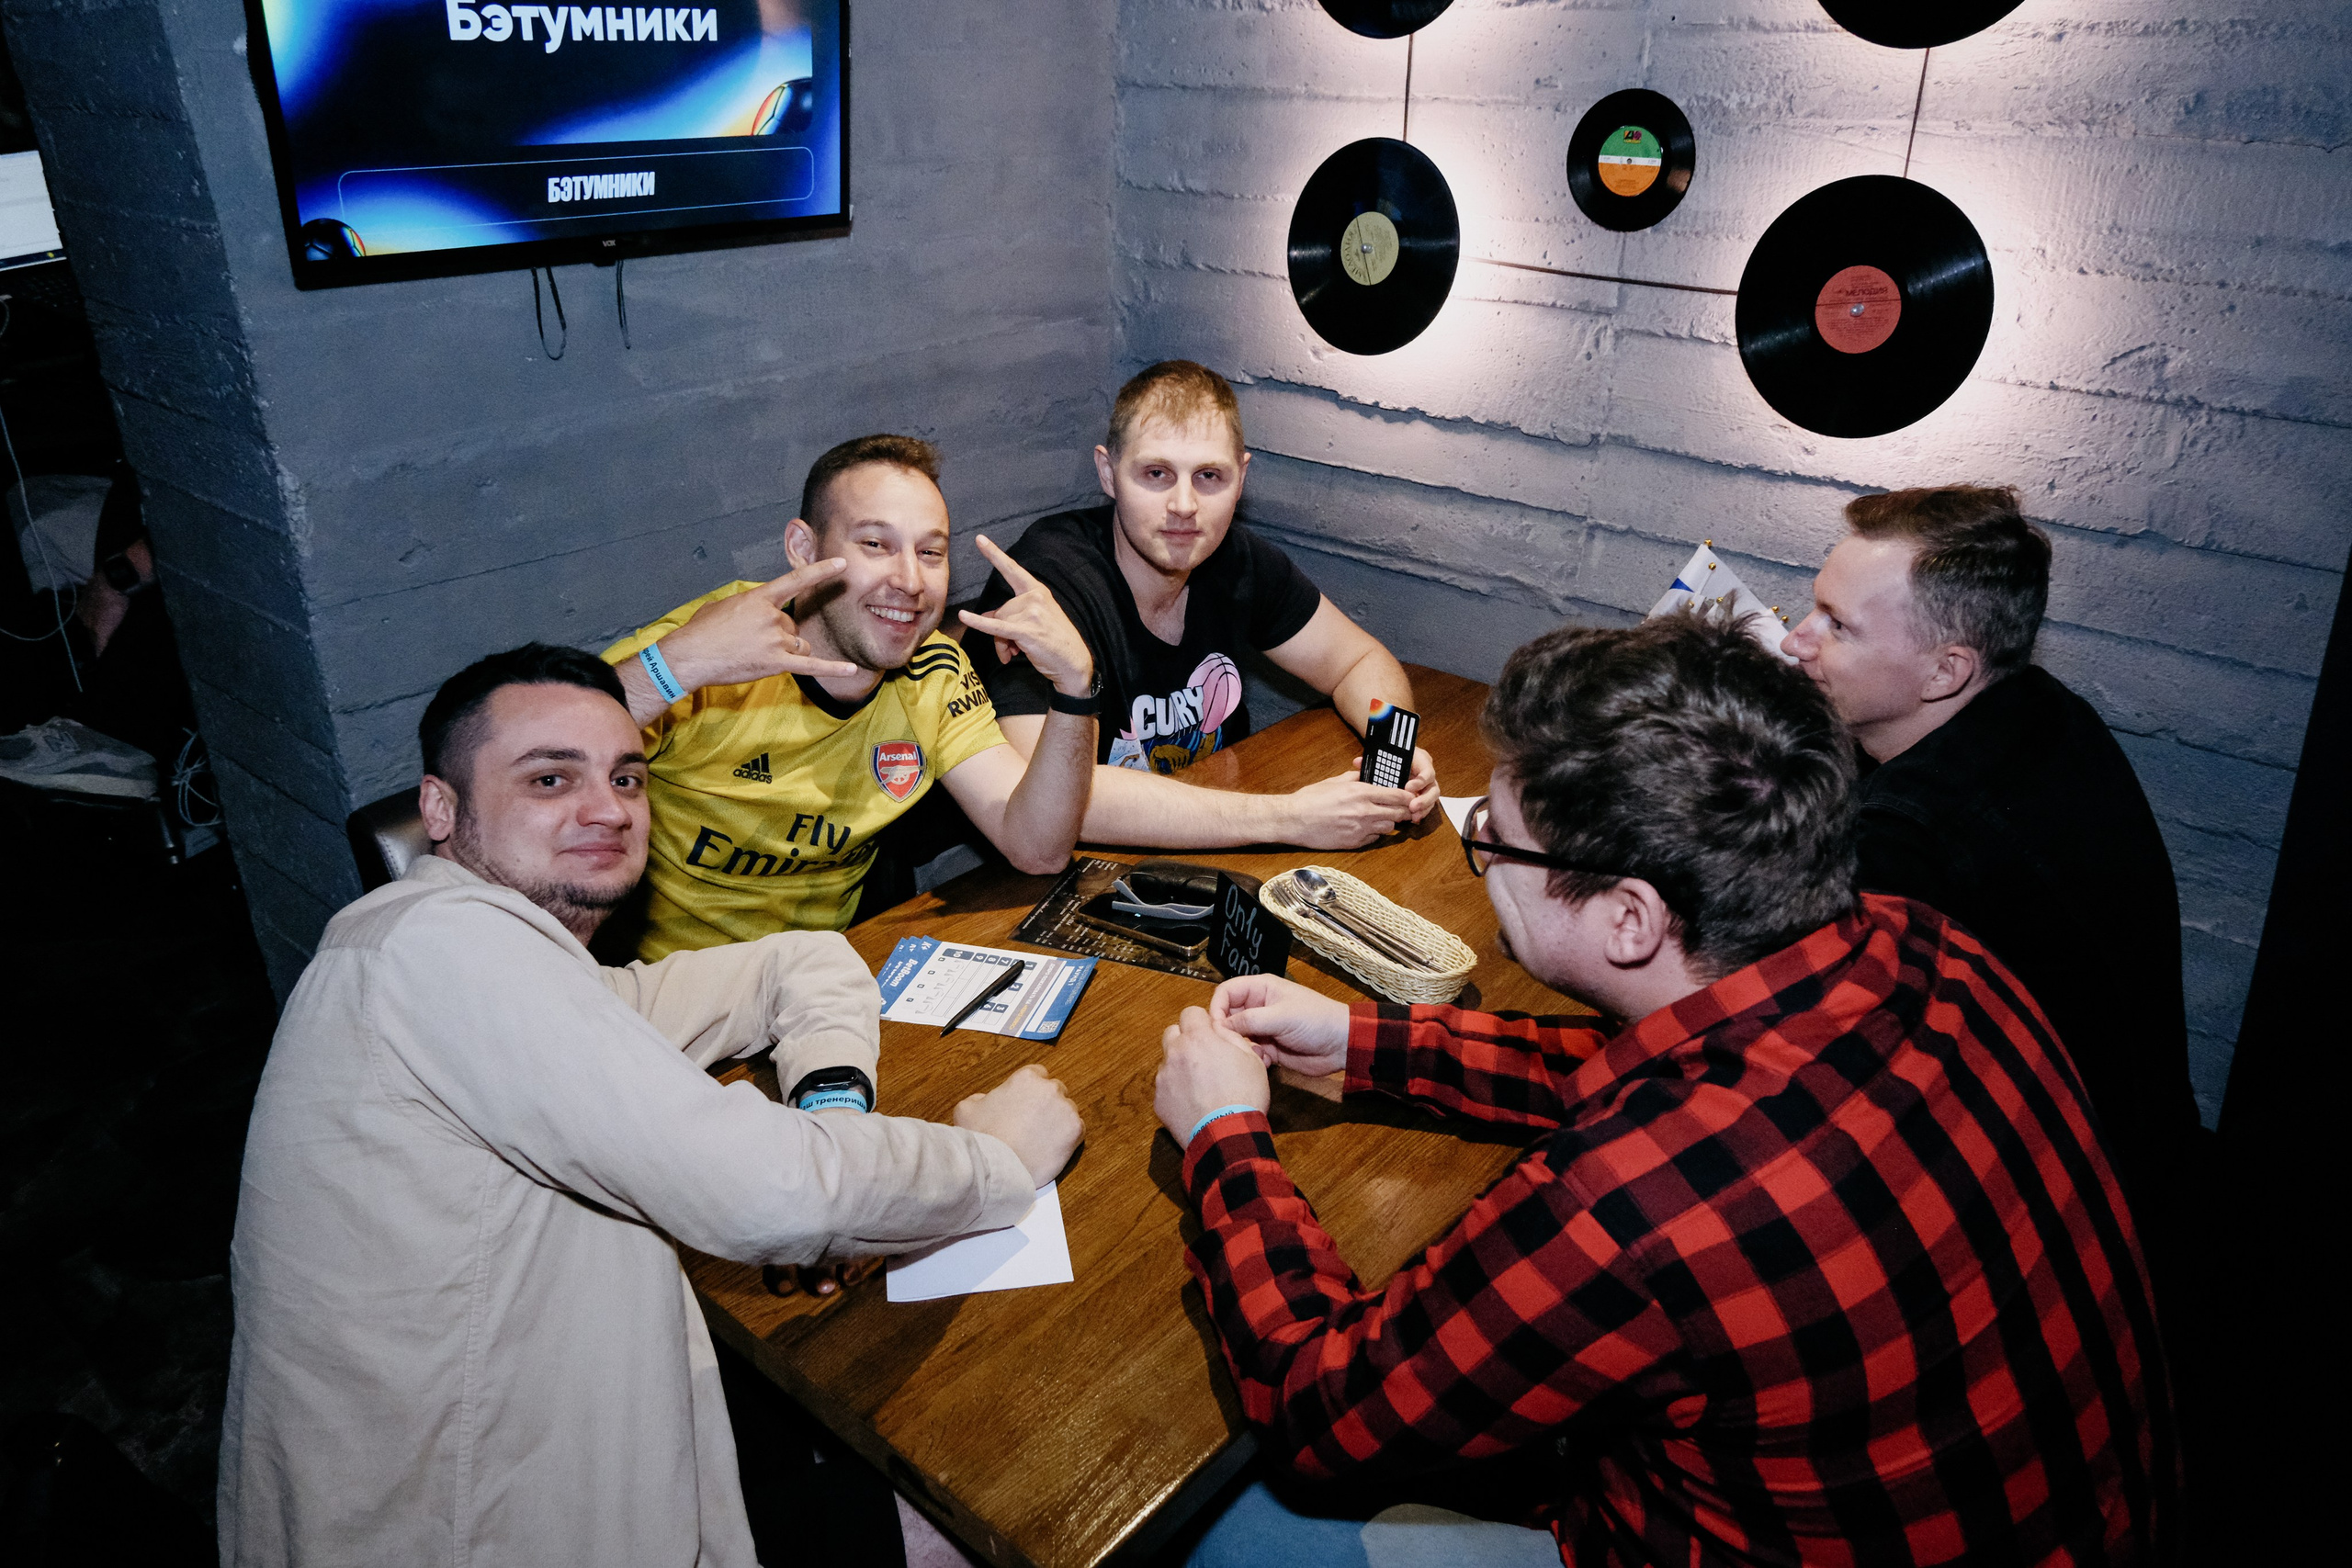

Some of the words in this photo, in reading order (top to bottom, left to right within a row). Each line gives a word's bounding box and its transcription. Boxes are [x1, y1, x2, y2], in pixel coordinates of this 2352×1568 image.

[447, 0, 718, 53] Бэтумники
[548, 171, 655, 203] БЭТУМНИКИ
[1845, 287, 1888, 297] МЕЛОДИЯ
[650, 661, 676, 699] Аршавин
[960, 671, 980, 691] VIS
[878, 750, 917, 762] Arsenal
[732, 768, 773, 784] adidas
[786, 813, 851, 855] Fly
[1225, 884, 1262, 960] Only
[953, 950, 963, 958] 10
[889, 958, 919, 987] BetBoom
